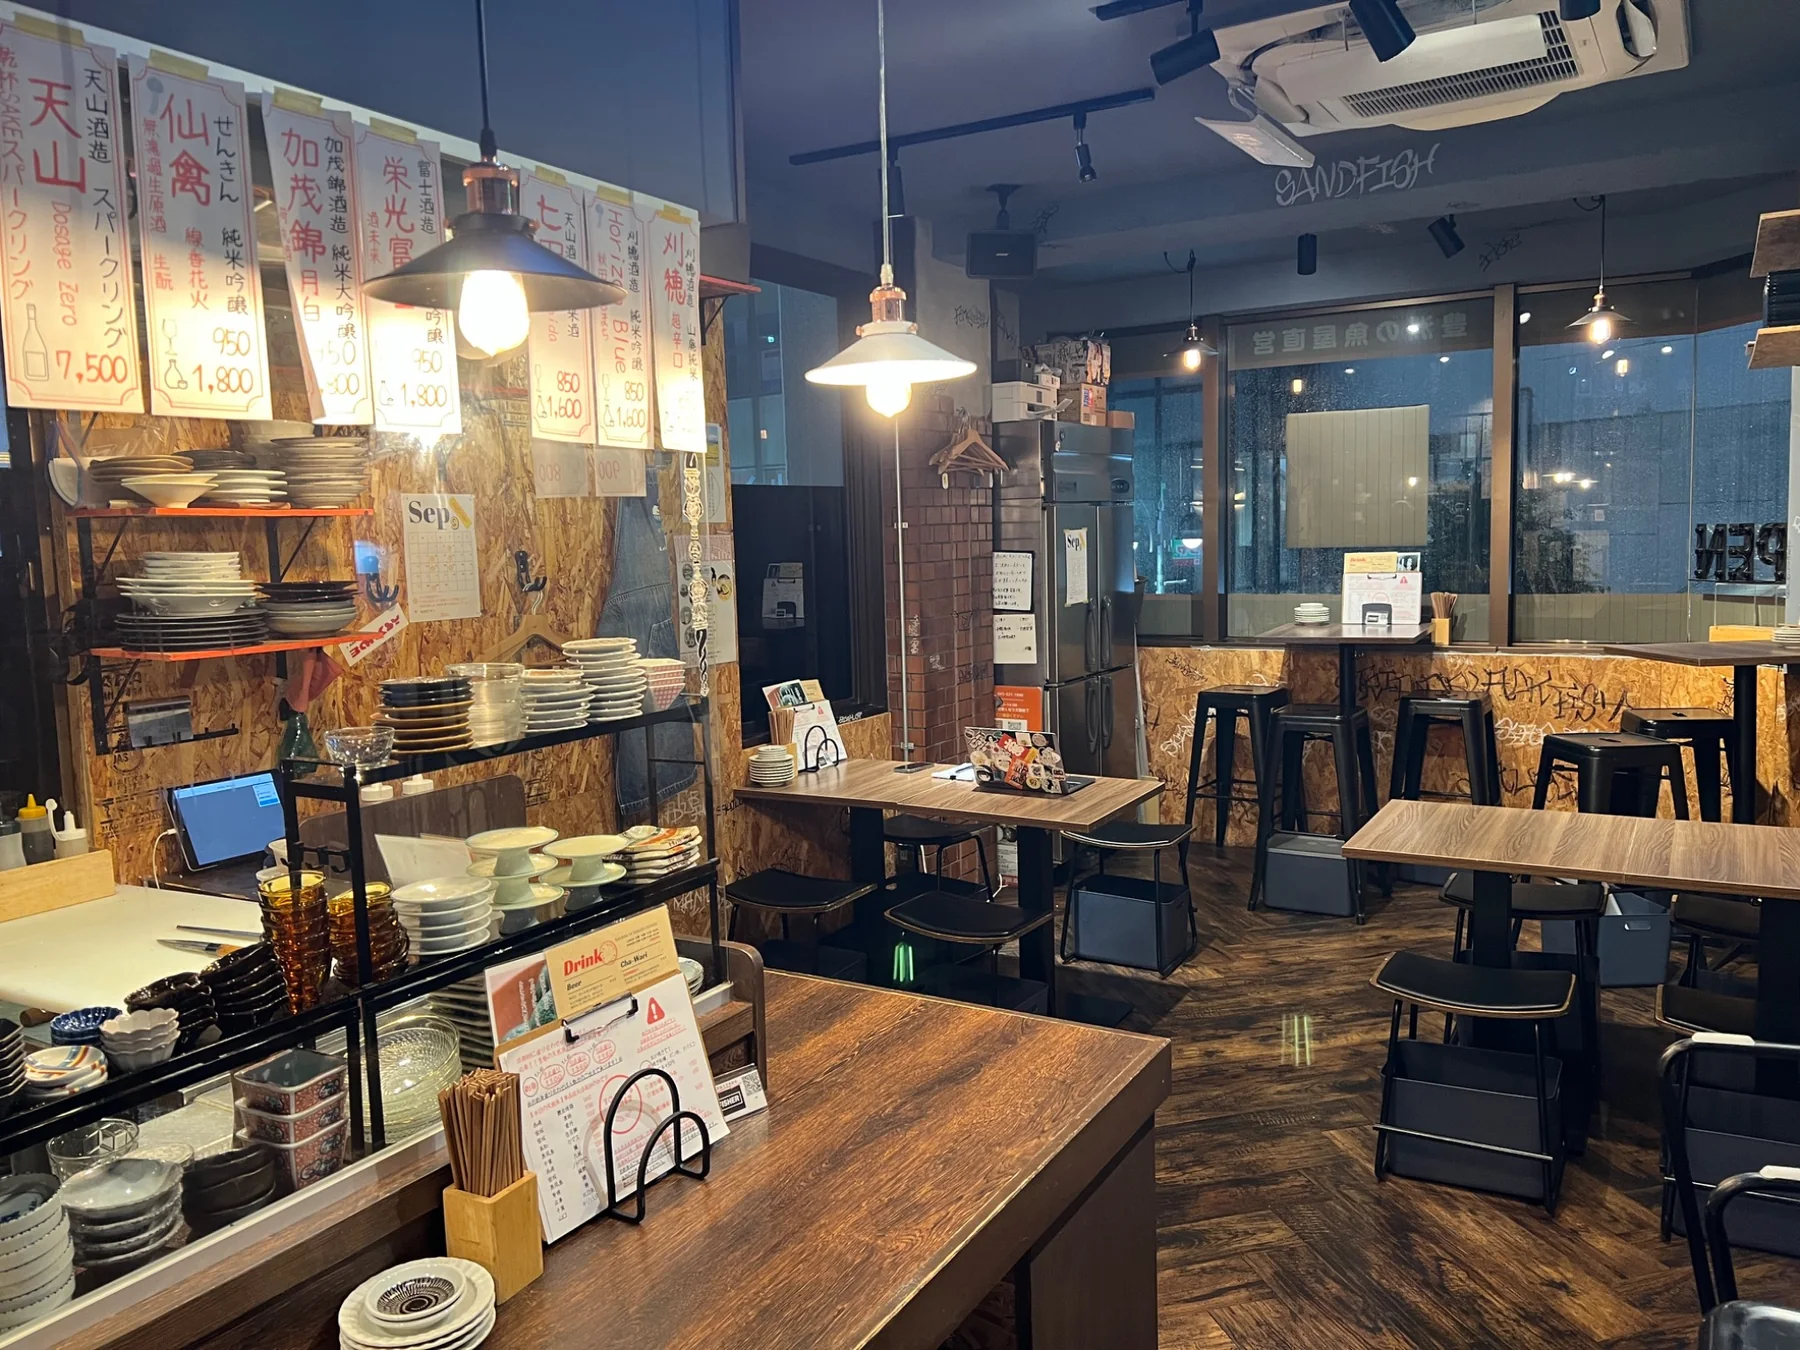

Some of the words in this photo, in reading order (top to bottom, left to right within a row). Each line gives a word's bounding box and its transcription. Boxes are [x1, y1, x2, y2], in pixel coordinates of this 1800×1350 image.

[28, 77, 87, 194] 天山
[84, 67, 112, 164] 天山酒造
[160, 93, 211, 207] 仙禽
[213, 116, 239, 203] せんきん
[1275, 143, 1441, 206] SANDFISH
[281, 128, 326, 264] 加茂錦
[324, 136, 348, 234] 加茂錦酒造
[417, 160, 436, 235] 富士酒造
[52, 201, 73, 270] Dosage
[383, 156, 416, 308] 栄光富
[93, 187, 127, 350] スパークリング
[222, 227, 249, 316] 純米吟醸
[627, 230, 640, 293] 刈穂酒造
[663, 232, 687, 306] 刈穂
[59, 281, 79, 327] Zero
[300, 269, 320, 322] 月白
[331, 243, 357, 339] 純米大吟醸
[56, 350, 128, 384] 7,500
[213, 327, 251, 357] 950
[412, 348, 442, 373] 950
[613, 319, 629, 374] Blue
[192, 364, 254, 395] 1,800
[557, 370, 580, 393] 850
[625, 381, 644, 402] 850
[547, 396, 582, 419] 1,600
[617, 407, 645, 428] 1,600
[408, 500, 450, 530] Sep
[1066, 535, 1080, 551] Sep
[564, 949, 603, 976] Drink
[567, 980, 582, 991] Beer
[620, 952, 648, 968] Cha-Wari
